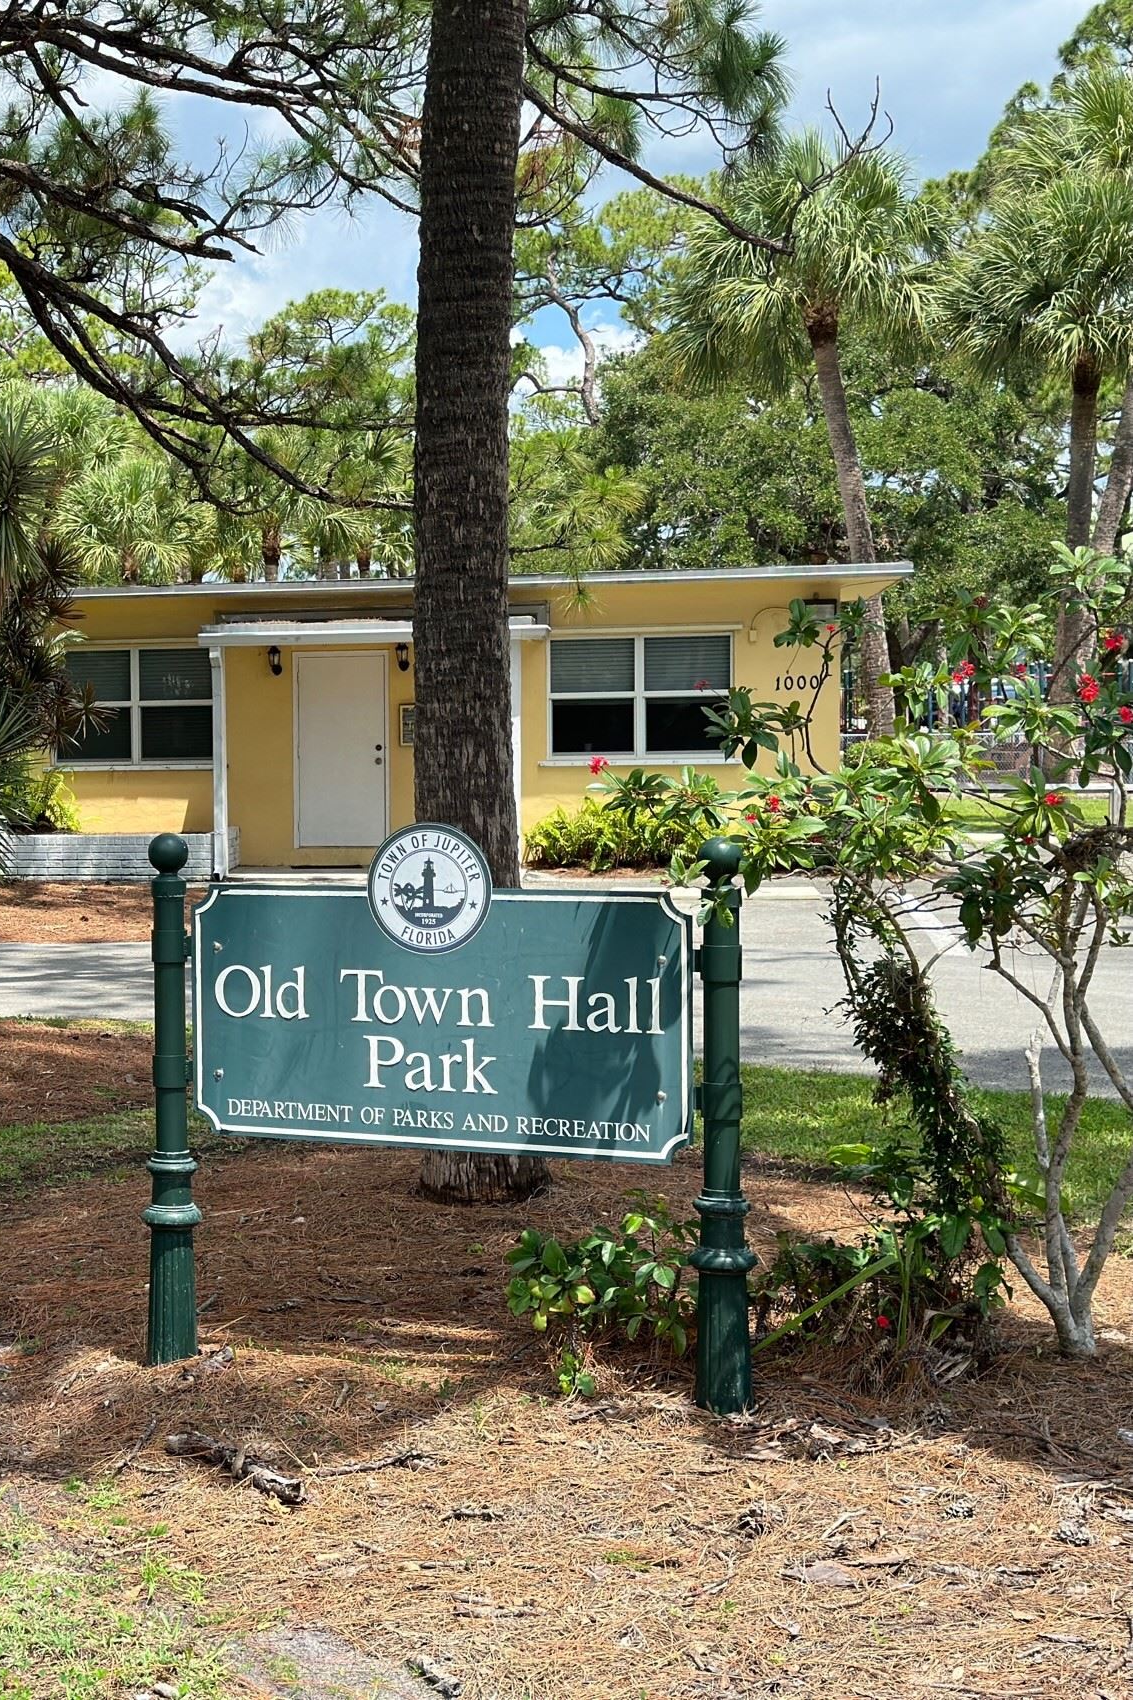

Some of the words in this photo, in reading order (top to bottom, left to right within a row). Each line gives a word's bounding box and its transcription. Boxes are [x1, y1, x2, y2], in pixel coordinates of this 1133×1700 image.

[775, 676, 819, 691] 1000
[378, 843, 407, 880] TOWN
[411, 834, 427, 849] OF
[433, 835, 481, 882] JUPITER
[401, 926, 456, 945] FLORIDA
[214, 965, 309, 1021] Old
[340, 969, 495, 1028] Town
[527, 975, 666, 1035] Hall
[363, 1035, 498, 1095] Park
[227, 1098, 353, 1124] DEPARTMENT
[360, 1107, 385, 1125] OF
[392, 1109, 454, 1130] PARKS
[461, 1113, 508, 1133] AND
[517, 1117, 651, 1143] RECREATION
